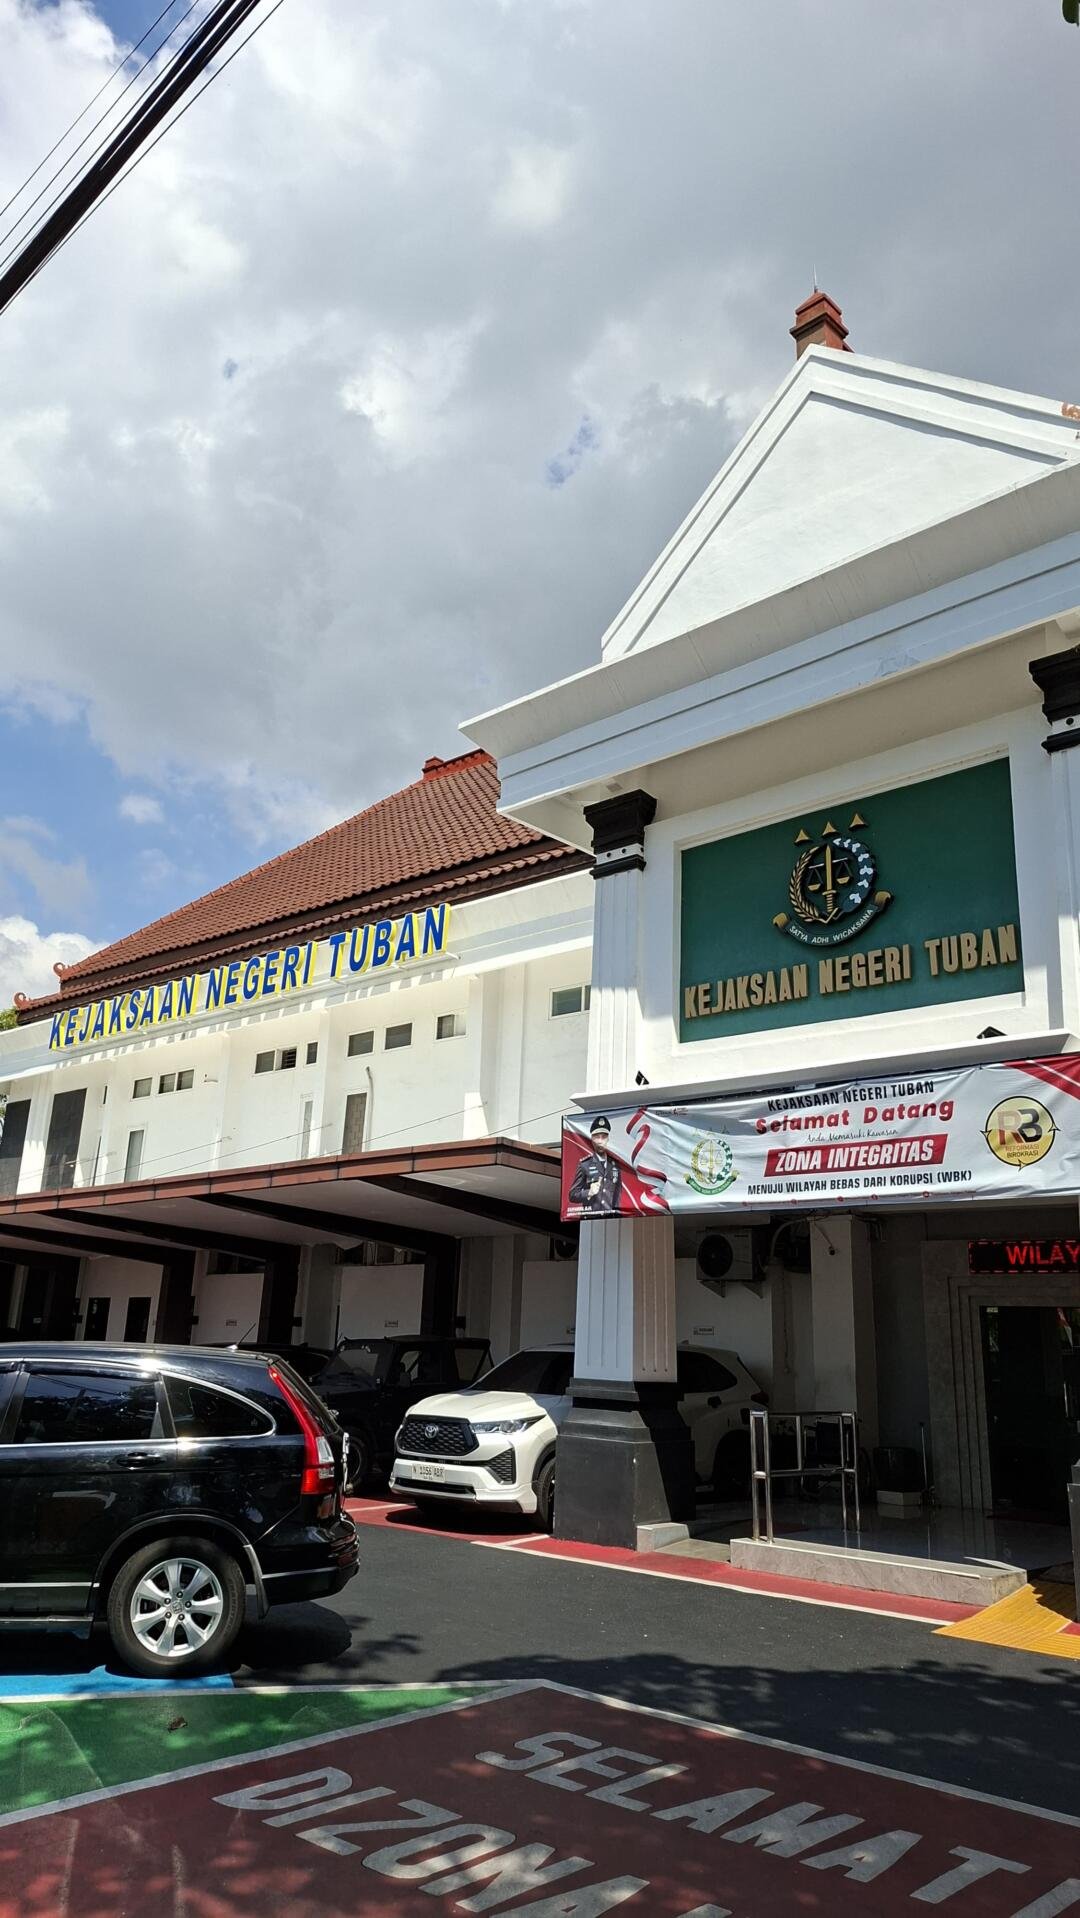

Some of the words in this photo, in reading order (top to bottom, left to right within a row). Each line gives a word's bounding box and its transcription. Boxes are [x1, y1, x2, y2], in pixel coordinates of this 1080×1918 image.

[789, 925, 808, 942] SATYA
[811, 936, 829, 945] ADHI
[832, 908, 874, 941] WICAKSANA
[49, 974, 200, 1051] KEJAKSAAN
[205, 941, 317, 1012] NEGERI
[329, 903, 450, 980] TUBAN
[684, 963, 808, 1019] KEJAKSAAN
[818, 944, 912, 994] NEGERI
[924, 924, 1018, 976] TUBAN
[767, 1091, 840, 1112] KEJAKSAAN
[843, 1085, 888, 1103] NEGERI
[892, 1080, 934, 1097] TUBAN
[755, 1110, 850, 1135] Selamat
[863, 1099, 954, 1124] Datang
[775, 1148, 824, 1173] ZONA
[827, 1139, 934, 1168] INTEGRITAS
[1006, 1150, 1038, 1158] BIROKRASI
[747, 1184, 783, 1195] MENUJU
[785, 1180, 827, 1193] WILAYAH
[830, 1179, 860, 1189] BEBAS
[863, 1176, 887, 1187] DARI
[889, 1173, 933, 1185] KORUPSI
[937, 1170, 972, 1183] (WBK)
[475, 1731, 1032, 1904] SELAMAT
